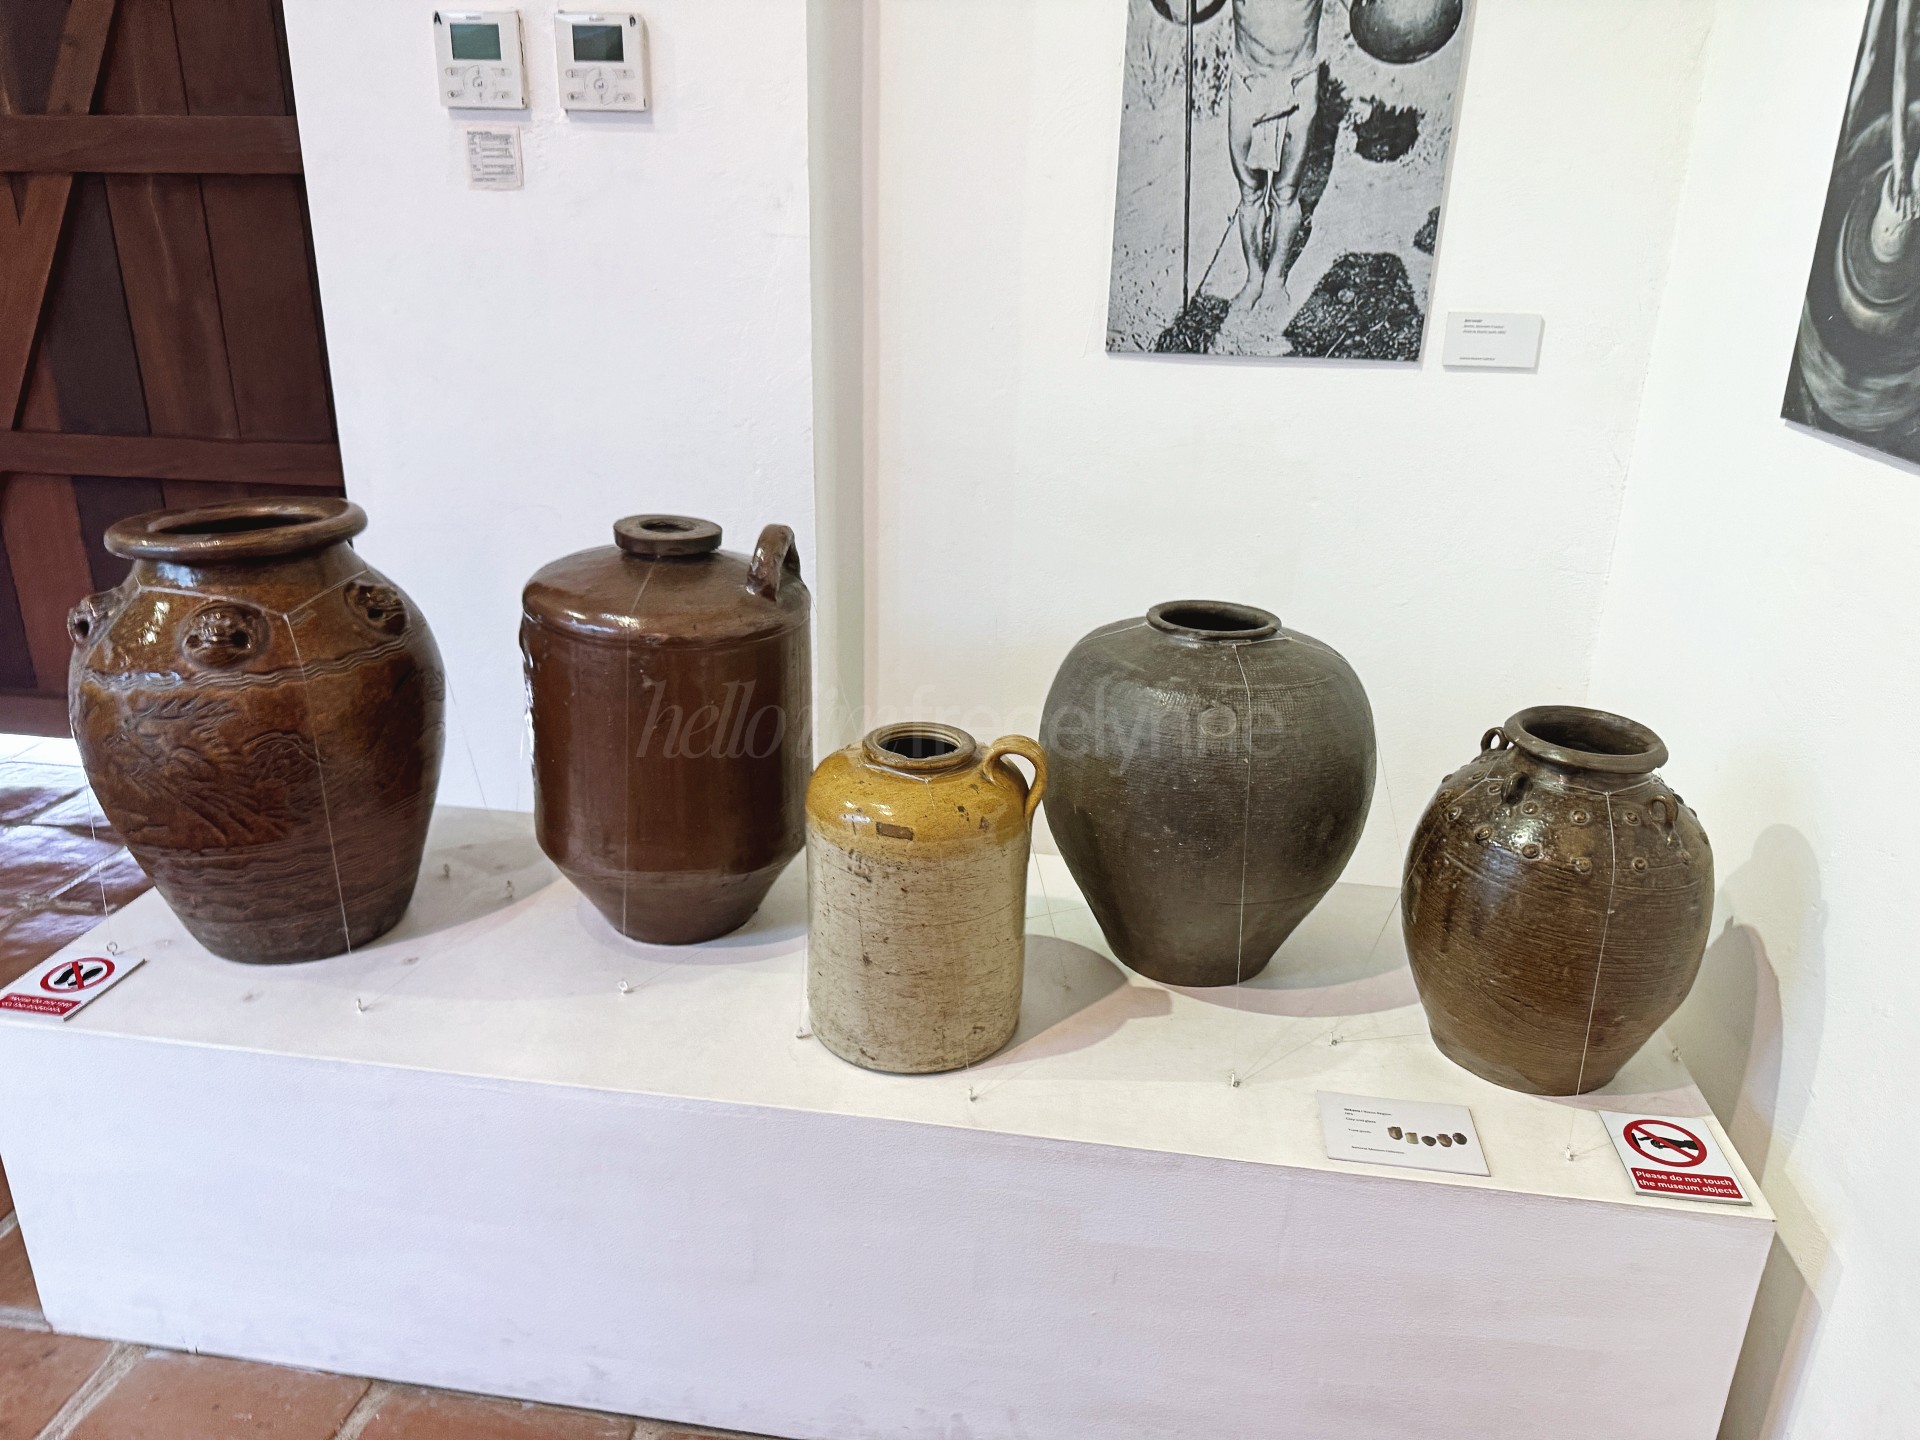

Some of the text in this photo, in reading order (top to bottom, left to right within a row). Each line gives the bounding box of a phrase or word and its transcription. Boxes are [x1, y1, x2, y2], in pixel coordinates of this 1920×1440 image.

[1635, 1170, 1733, 1187] Please do not touch
[1638, 1179, 1739, 1195] the museum objects
